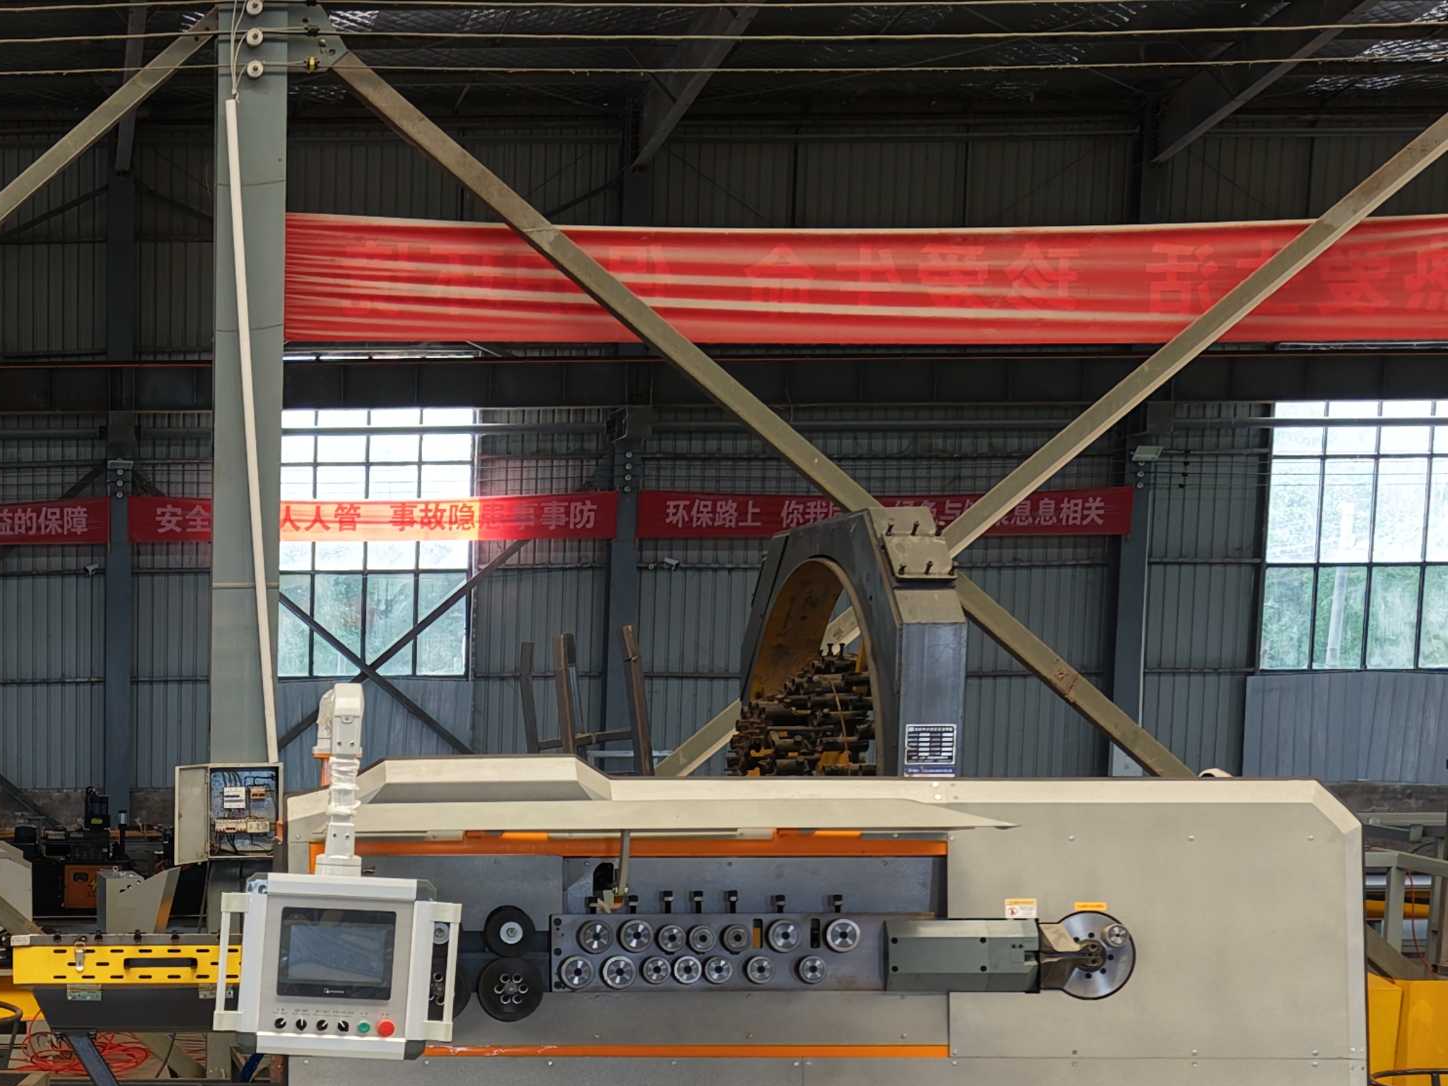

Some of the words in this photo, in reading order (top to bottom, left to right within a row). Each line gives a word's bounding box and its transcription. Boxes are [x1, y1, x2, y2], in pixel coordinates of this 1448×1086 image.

[665, 499, 761, 529] 环保路上
[781, 499, 841, 528] 你我
